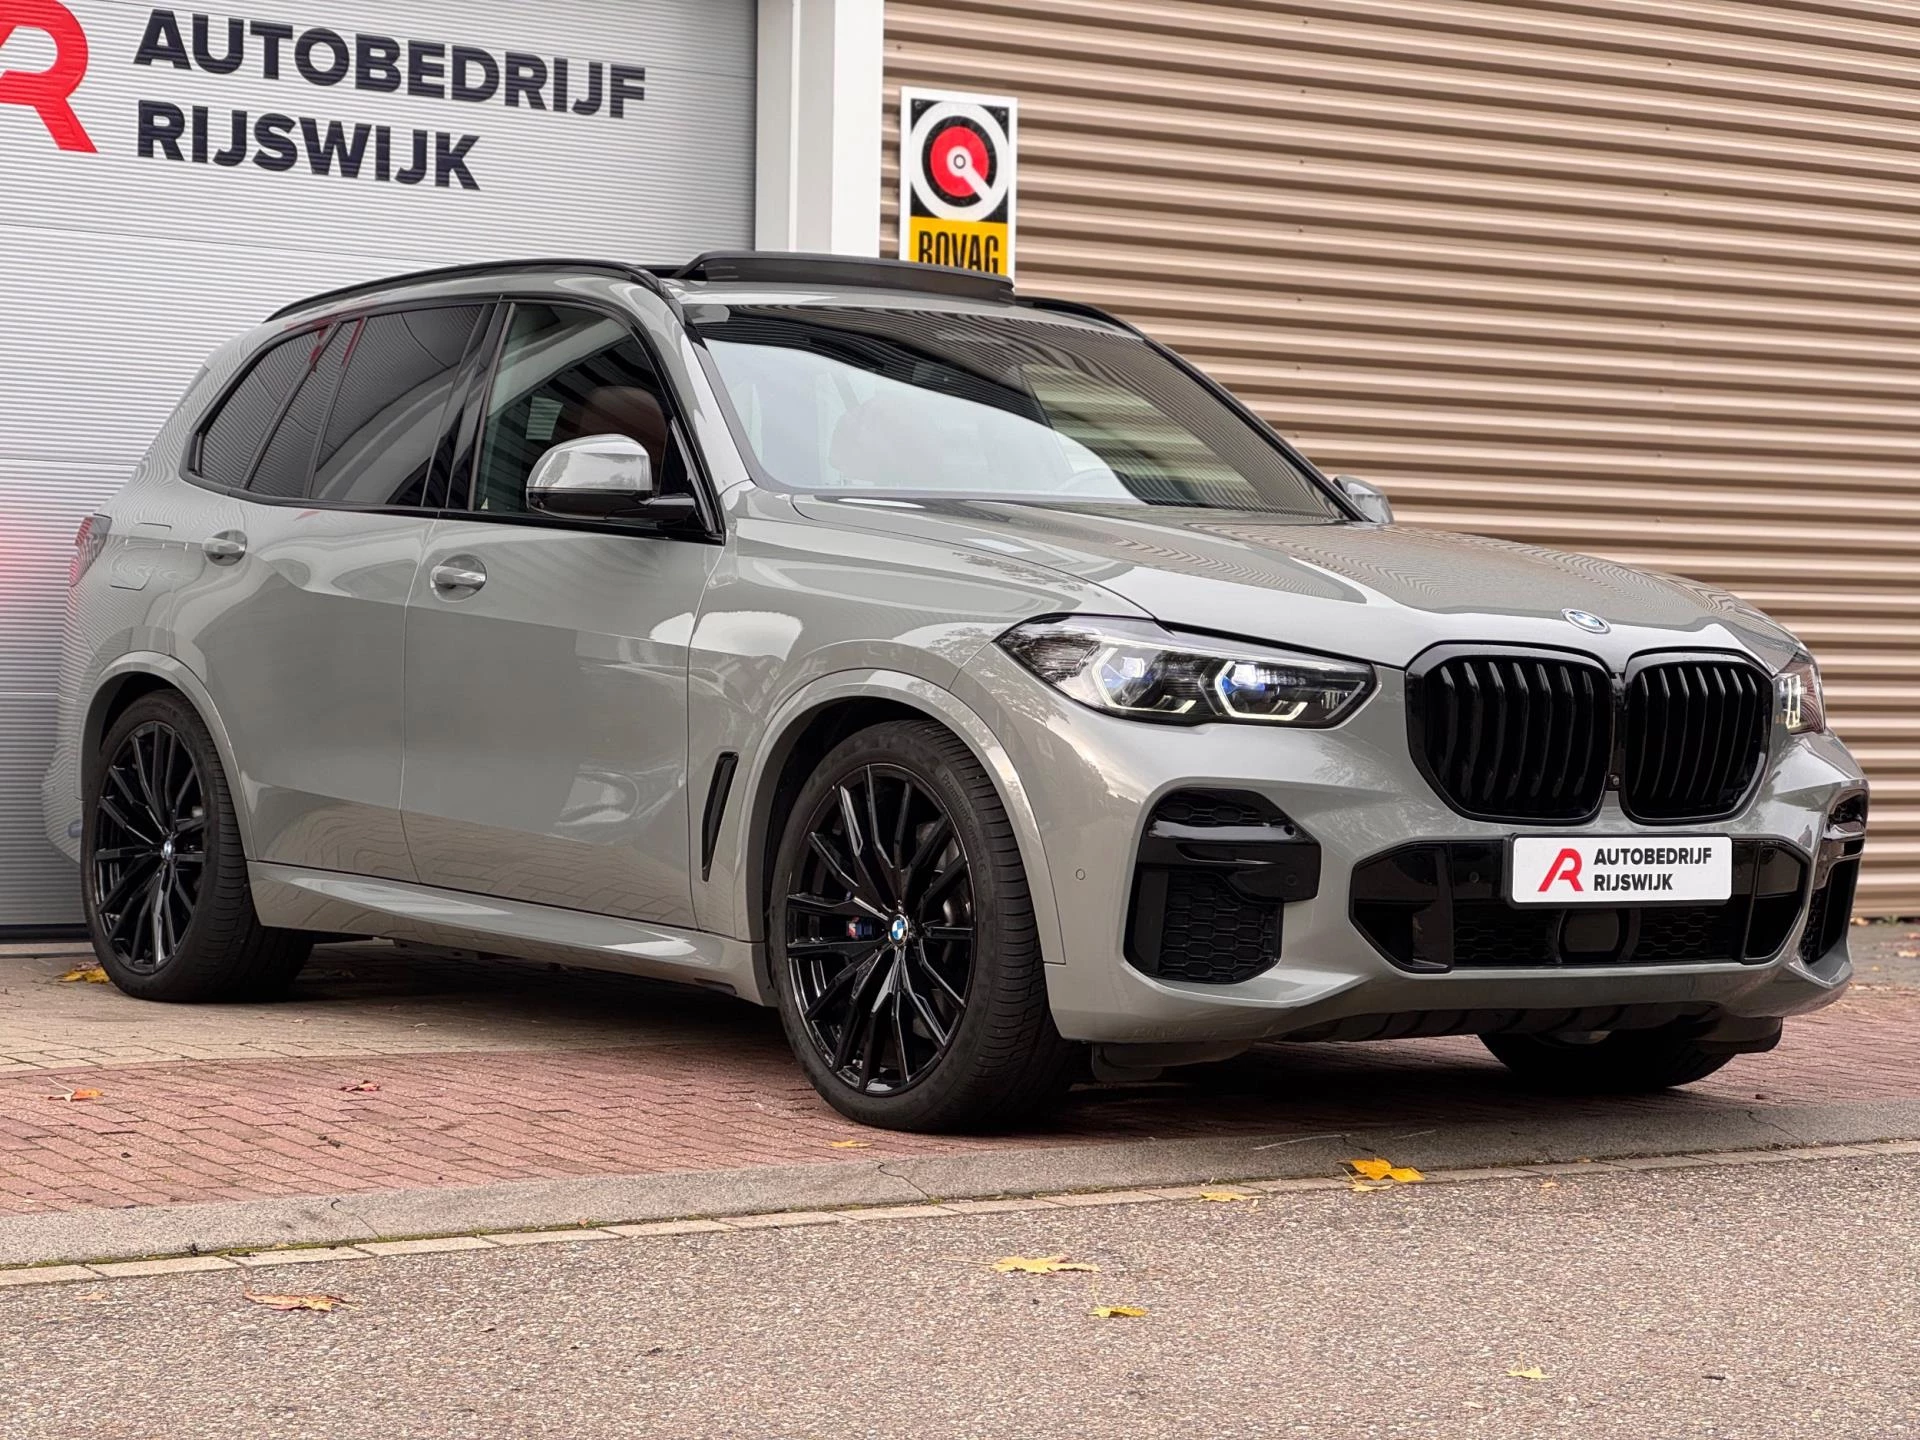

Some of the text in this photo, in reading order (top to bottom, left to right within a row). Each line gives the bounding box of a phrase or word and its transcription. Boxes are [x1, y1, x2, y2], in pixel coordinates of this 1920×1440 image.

[134, 9, 645, 119] AUTOBEDRIJF
[137, 100, 480, 191] RIJSWIJK
[1594, 848, 1711, 865] AUTOBEDRIJF
[1594, 873, 1673, 891] RIJSWIJK
